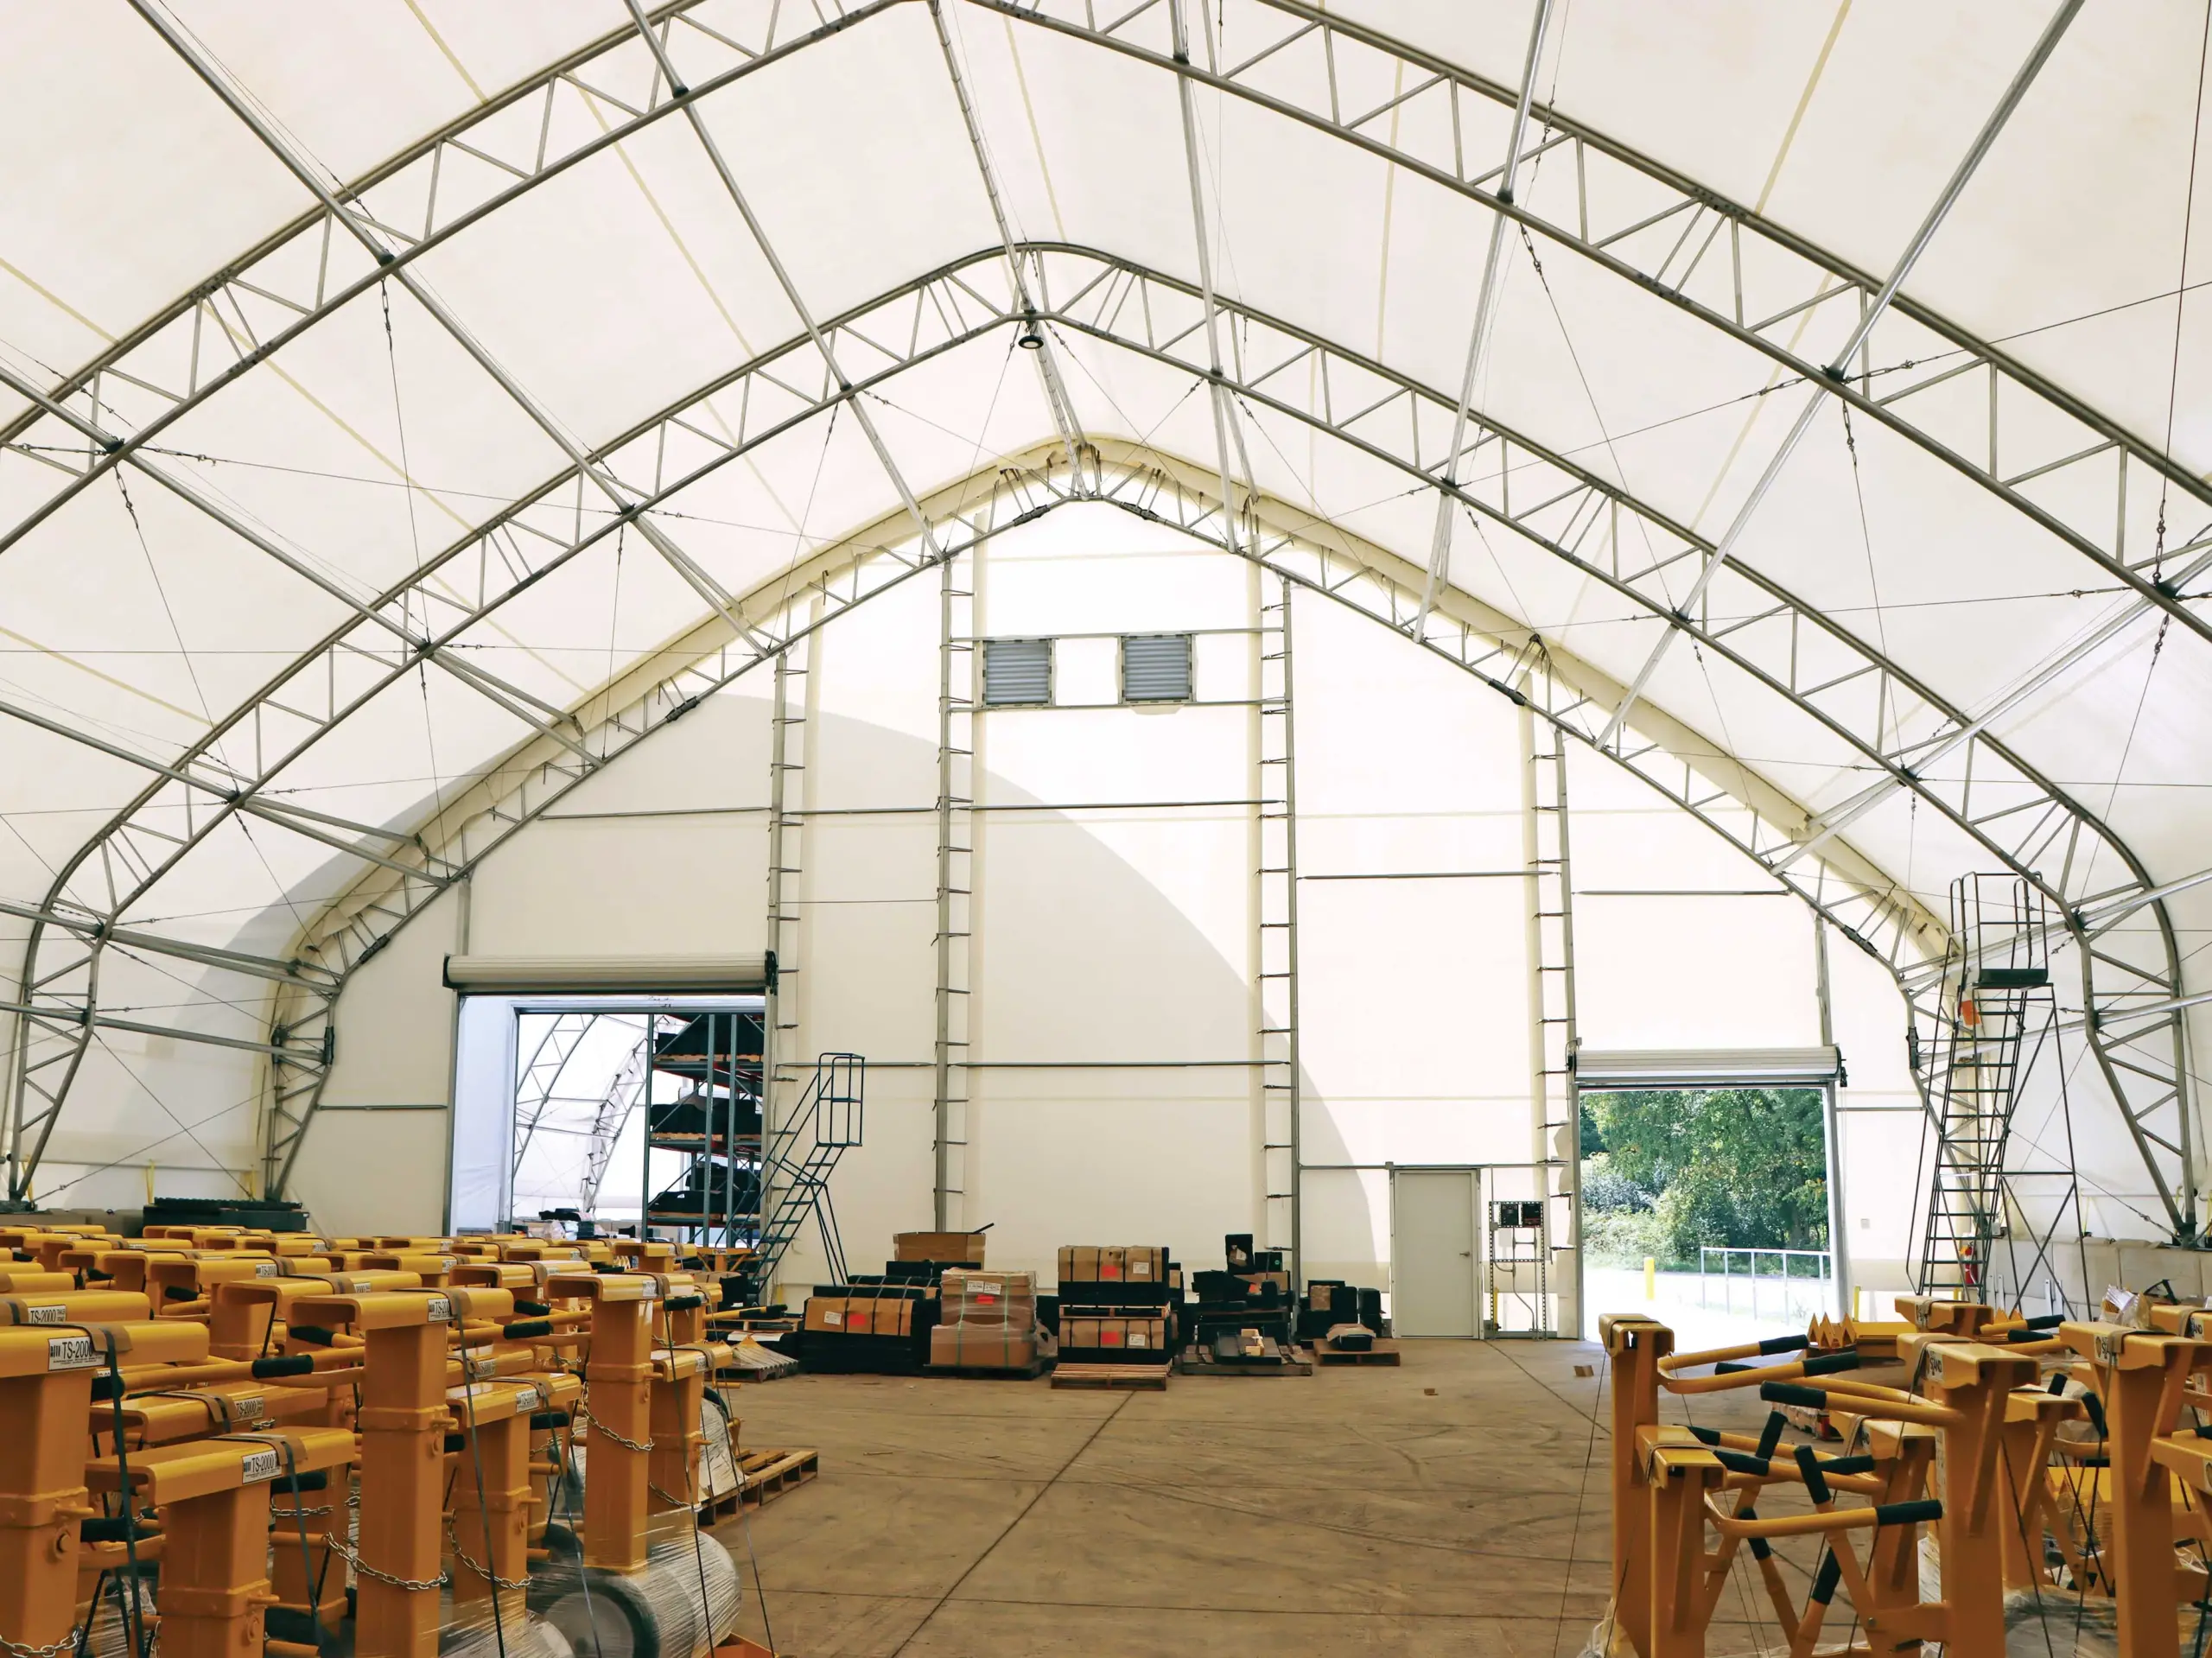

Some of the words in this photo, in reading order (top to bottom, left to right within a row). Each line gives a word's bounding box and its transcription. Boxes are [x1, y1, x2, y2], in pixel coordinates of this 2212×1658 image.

[30, 1309, 56, 1324] TS-2000
[236, 1401, 257, 1415] TS-2000
[251, 1453, 275, 1473] TS-2000
